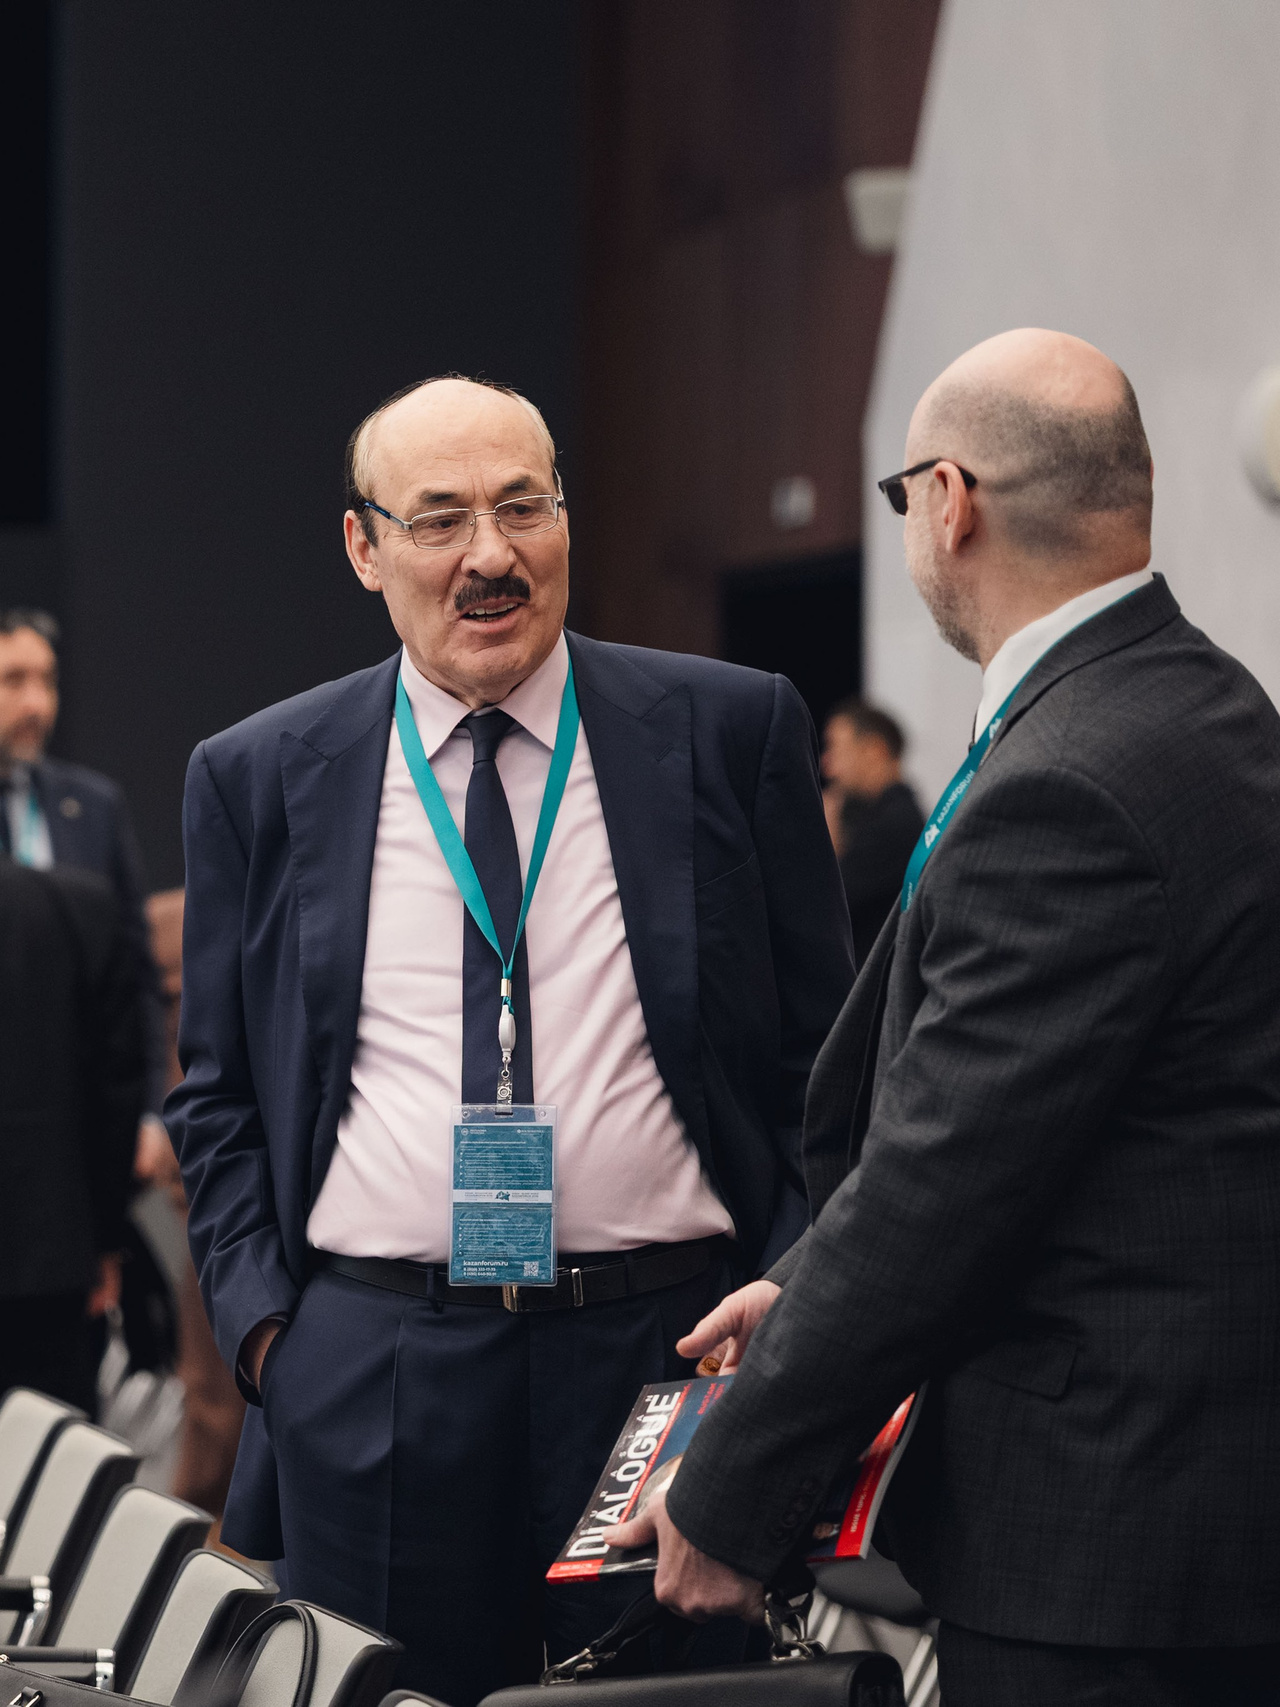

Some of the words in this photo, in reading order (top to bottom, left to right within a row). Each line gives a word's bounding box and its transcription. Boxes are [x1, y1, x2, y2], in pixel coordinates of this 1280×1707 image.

[937, 770, 975, 824] KAZANFORUM
[566, 1391, 682, 1557] DIALOGUE
[580, 1395, 655, 1536] EURASIAN
